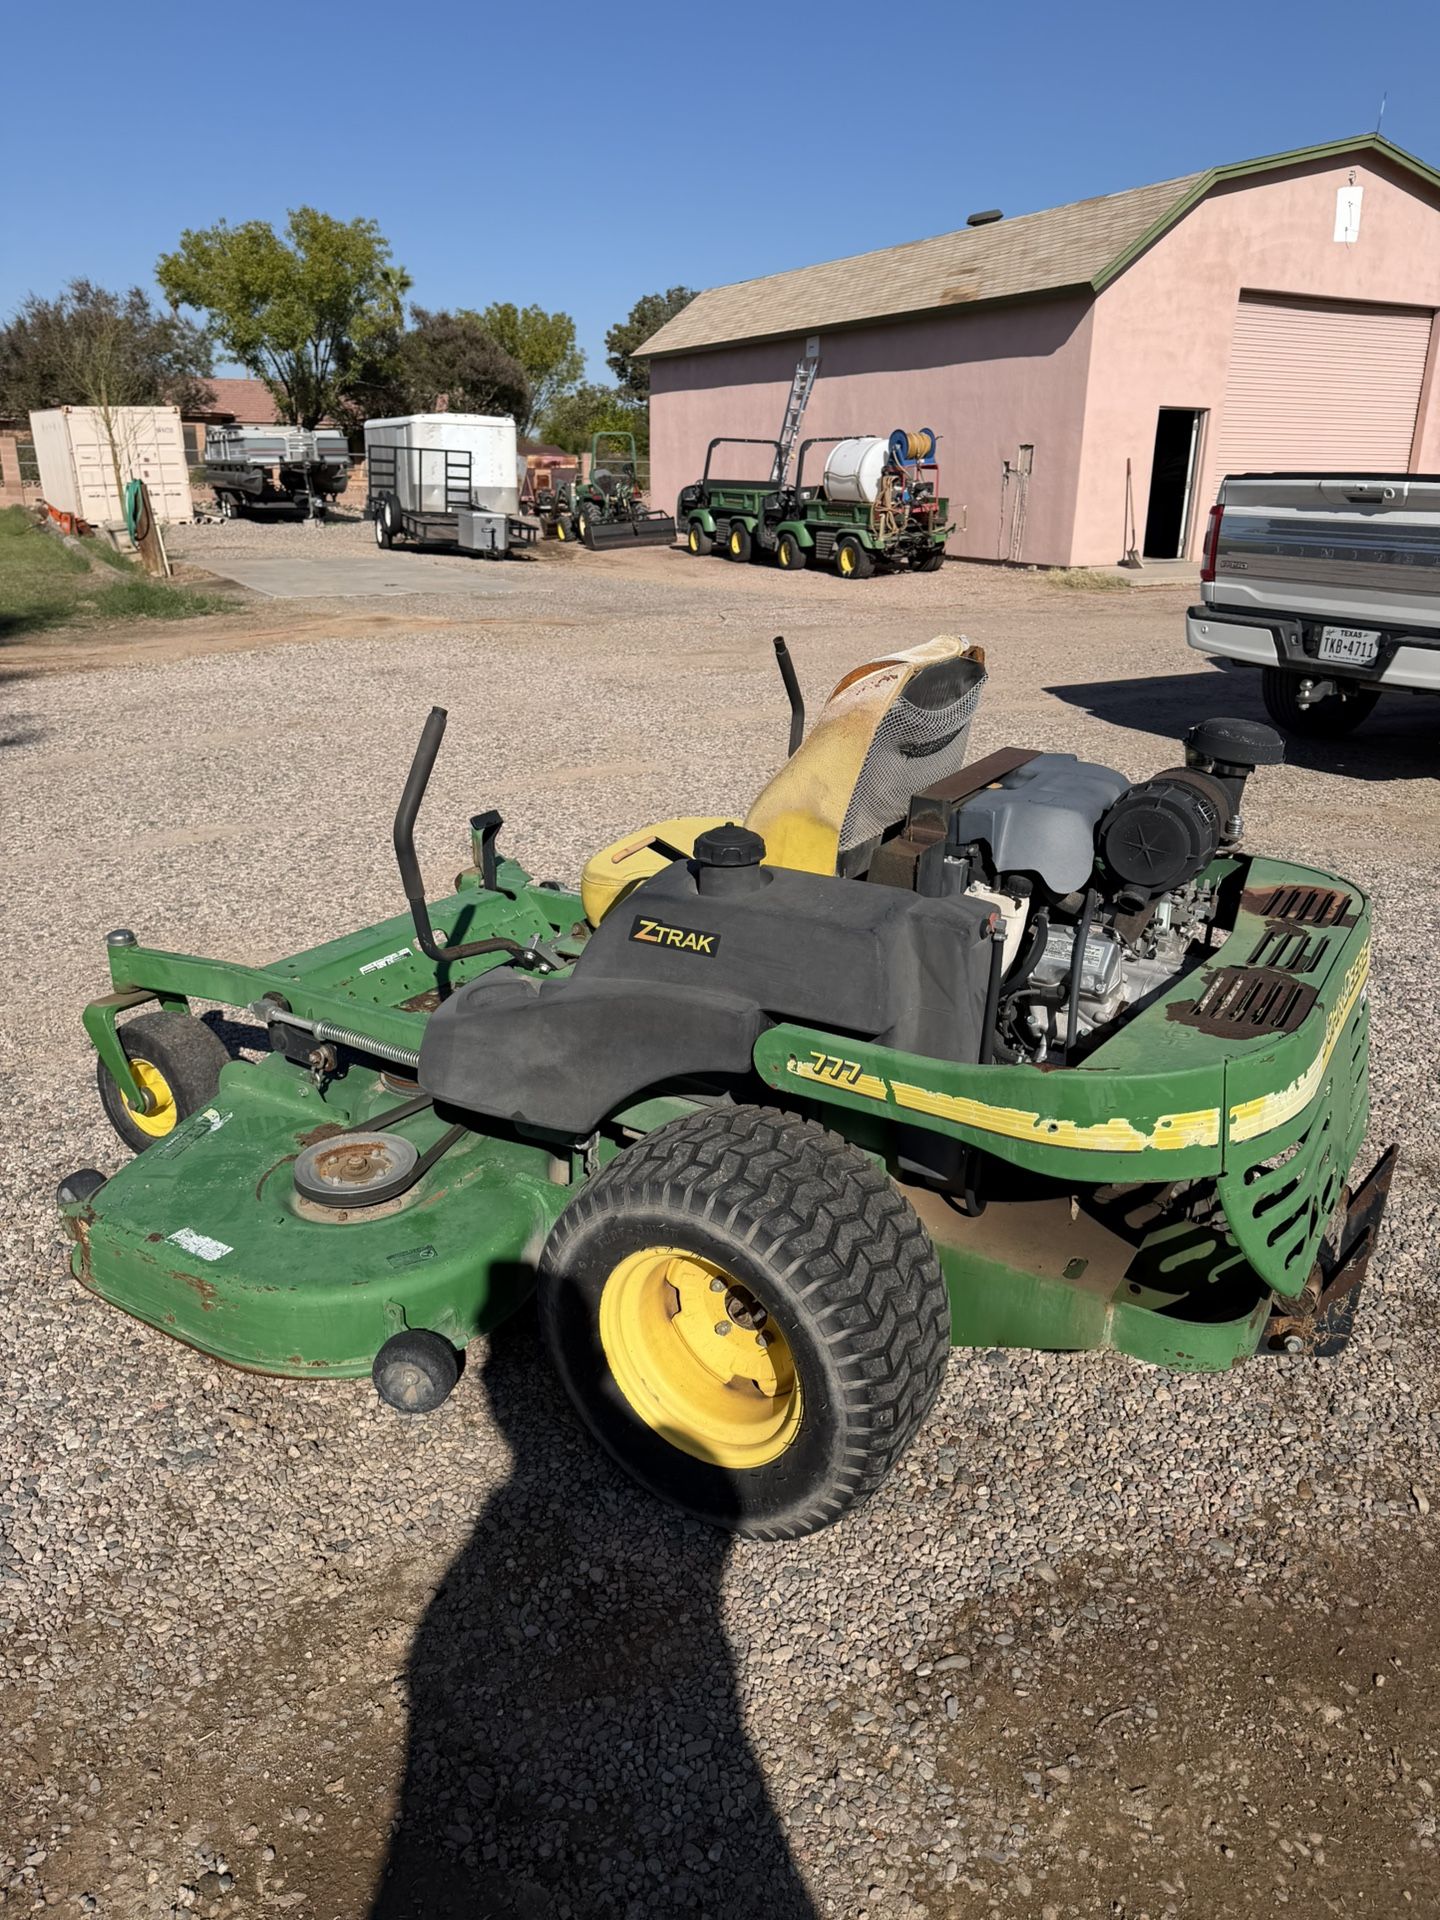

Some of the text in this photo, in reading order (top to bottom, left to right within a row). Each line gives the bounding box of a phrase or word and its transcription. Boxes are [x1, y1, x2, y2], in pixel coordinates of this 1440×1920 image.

[1341, 629, 1363, 639] TEXAS
[633, 918, 715, 954] ZTRAK
[810, 1050, 863, 1085] 777
